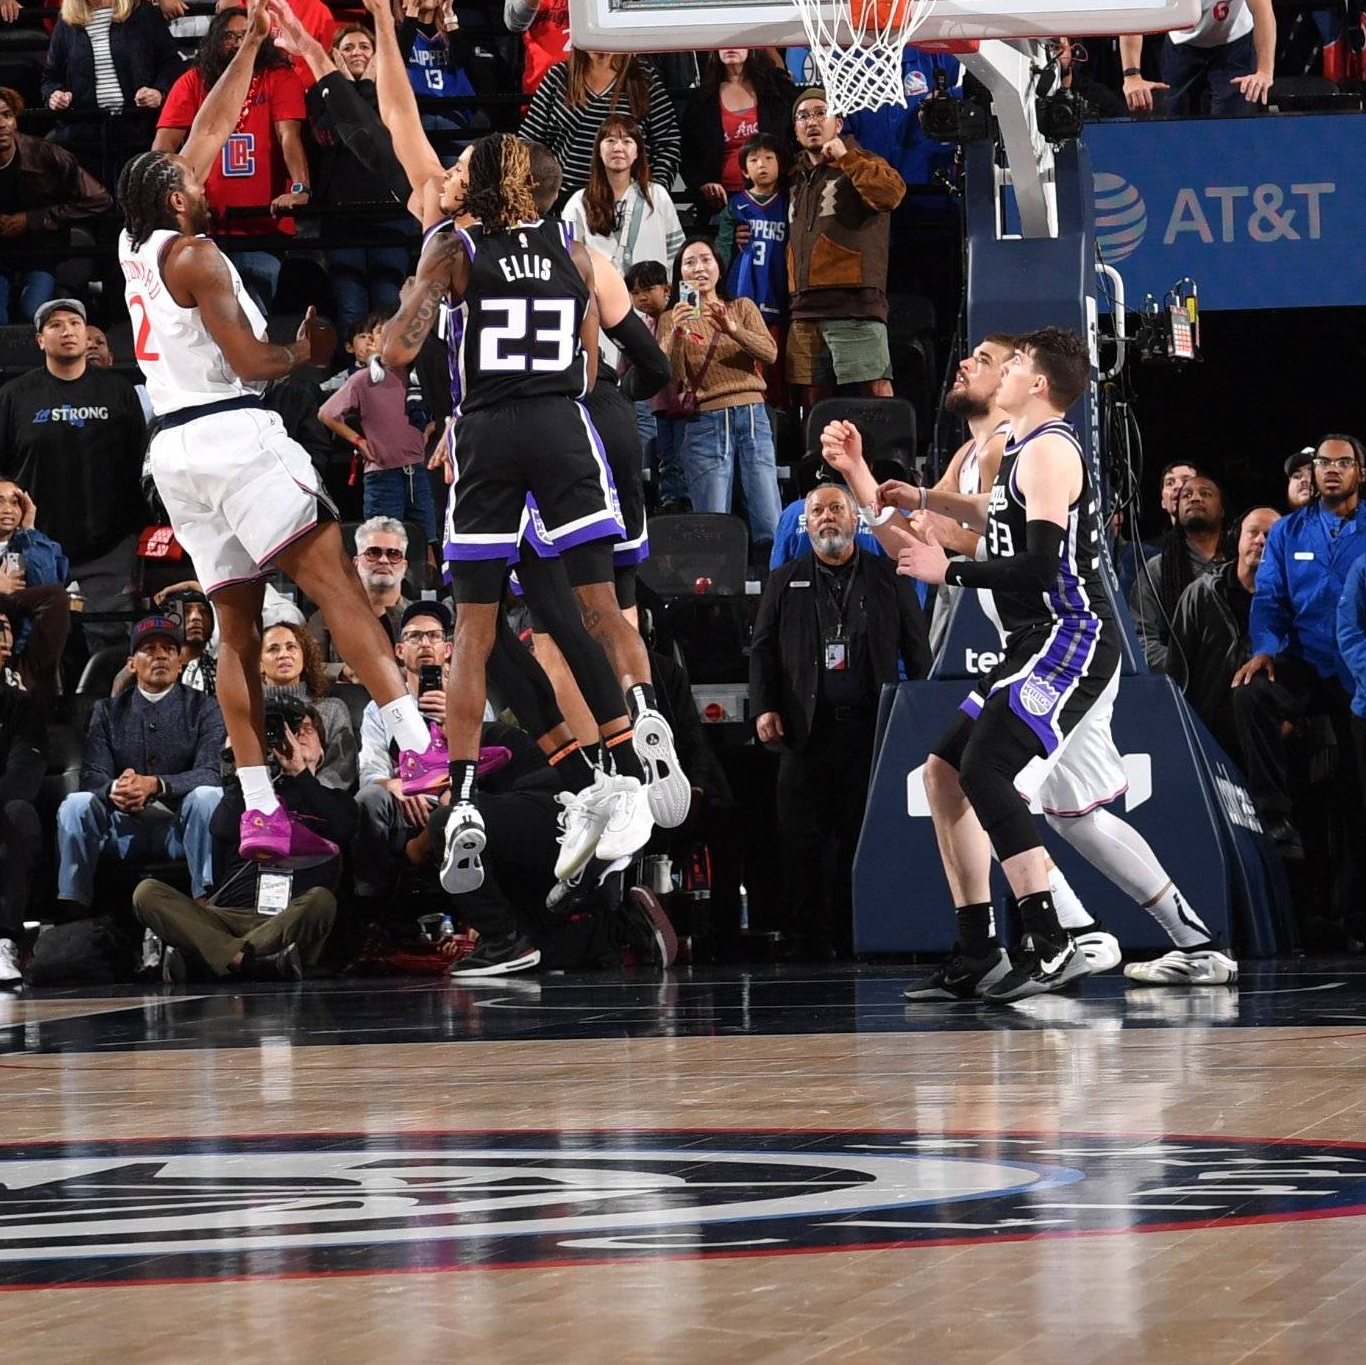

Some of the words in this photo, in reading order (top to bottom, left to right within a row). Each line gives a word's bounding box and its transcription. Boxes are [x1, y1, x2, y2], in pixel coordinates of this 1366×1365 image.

[424, 67, 445, 92] 13
[1162, 182, 1337, 246] AT&T
[497, 252, 554, 287] ELLIS
[130, 294, 162, 362] 2
[478, 297, 578, 373] 23
[51, 405, 110, 422] STRONG
[986, 518, 1015, 559] 33
[1023, 684, 1053, 707] KINGS
